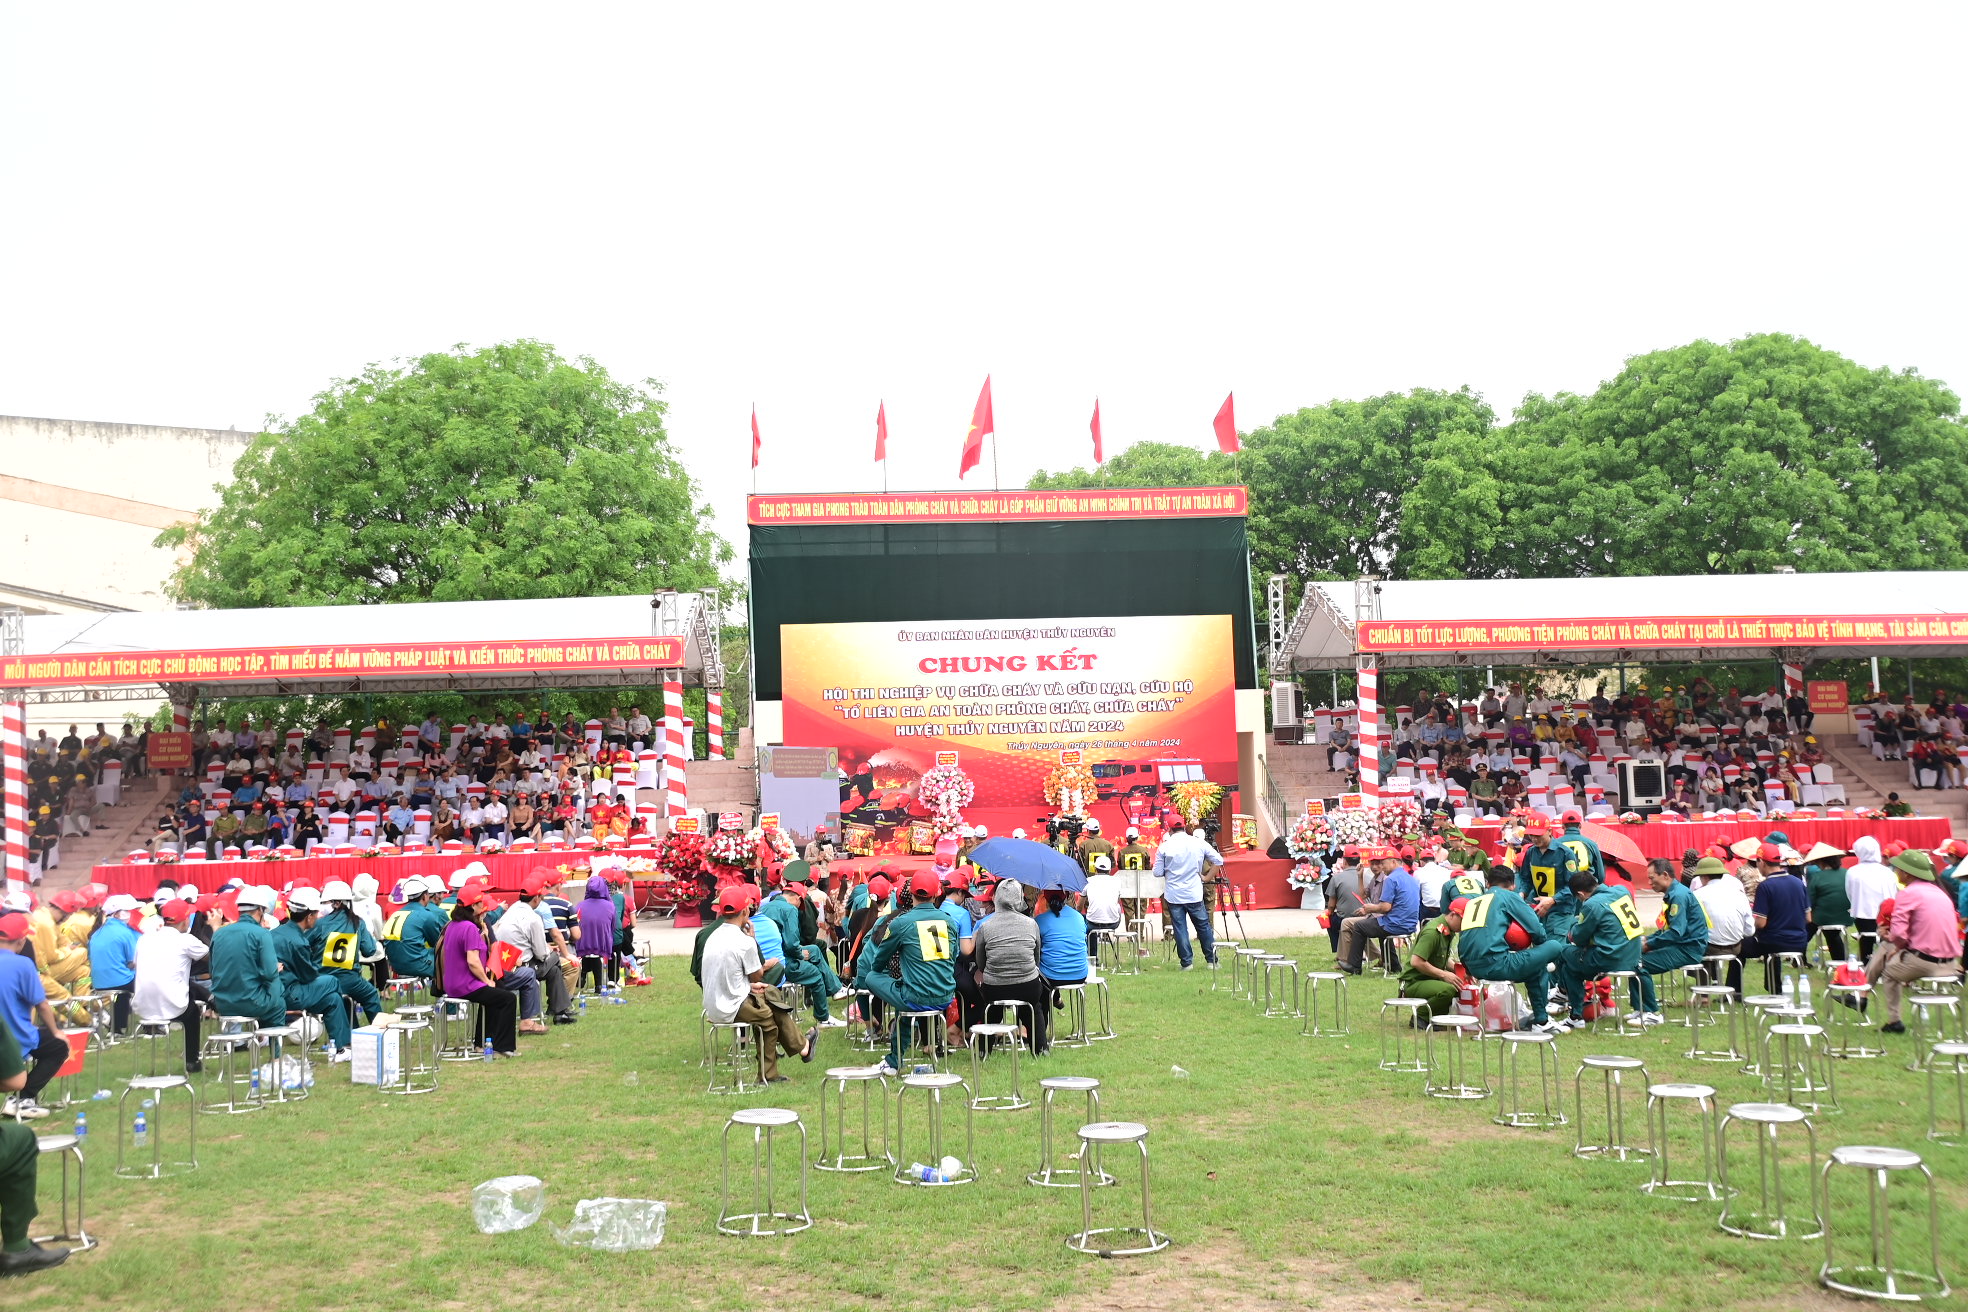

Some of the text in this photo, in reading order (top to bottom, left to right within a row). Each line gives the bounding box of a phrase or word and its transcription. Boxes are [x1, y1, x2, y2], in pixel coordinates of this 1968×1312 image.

[916, 632, 939, 641] BAN
[942, 630, 973, 640] NHÂN
[976, 629, 999, 640] DÂN
[1001, 628, 1038, 640] HUYỆN
[1041, 627, 1068, 638] THỦY
[1071, 627, 1115, 637] NGUYÊN
[1404, 629, 1414, 647] BỊ
[1417, 624, 1432, 643] TỐT
[1435, 627, 1453, 646] LỰC
[1456, 627, 1490, 646] LƯỢNG,
[1492, 626, 1530, 642] PHƯƠNG
[1533, 624, 1554, 645] TIỆN
[1557, 623, 1589, 641] PHÒNG
[1592, 623, 1616, 641] CHÁY
[1618, 622, 1631, 640] VÀ
[1634, 621, 1659, 640] CHỮA
[1662, 622, 1686, 640] CHÁY
[1689, 624, 1703, 643] TẠI
[1706, 619, 1724, 639] CHỖ
[1728, 621, 1739, 639] LÀ
[1741, 620, 1767, 639] THIẾT
[1769, 622, 1794, 642] THỰC
[1796, 619, 1815, 638] BẢO
[1816, 620, 1828, 641] VỆ
[1831, 620, 1853, 638] TÍNH
[1856, 623, 1887, 641] MẠNG,
[1889, 620, 1904, 637] TÀI
[1906, 618, 1927, 637] SẢN
[1929, 617, 1949, 636] CỦA
[5, 659, 25, 679] MỖI
[29, 659, 60, 678] NGƯỜI
[64, 659, 86, 677] DÂN
[114, 657, 136, 675] TÍCH
[140, 658, 161, 677] CỰC
[165, 654, 185, 673] CHỦ
[189, 655, 217, 676] ĐỘNG
[221, 657, 241, 675] HỌC
[245, 653, 267, 674] TẬP,
[271, 652, 289, 670] TÌM
[363, 649, 391, 667] VỮNG
[394, 648, 422, 666] PHÁP
[425, 648, 450, 668] LUẬT
[453, 647, 467, 665] VÀ
[470, 645, 494, 664] KIẾN
[498, 645, 524, 664] THỨC
[527, 644, 563, 663] PHÒNG
[566, 644, 593, 662] CHÁY
[596, 643, 610, 661] VÀ
[613, 642, 640, 661] CHỮA
[644, 642, 670, 659] CHÁY
[918, 647, 1097, 673] CHUNG KẾT
[823, 680, 1194, 702] HỘI THI NGHIỆP VỤ CHỮA CHÁY VÀ CỨU NẠN, CỨU HỘ
[834, 697, 1183, 719] “TỔ LIÊN GIA AN TOÀN PHÒNG CHÁY, CHỮA CHÁY”
[895, 719, 1124, 738] HUYỆN THỦY NGUYÊN NĂM 2024
[1030, 742, 1067, 750] Nguyên,
[1069, 741, 1091, 749] ngày
[1092, 740, 1103, 748] 26
[1104, 740, 1129, 749] tháng
[1528, 818, 1540, 826] 114
[1462, 879, 1474, 890] 3
[1536, 872, 1548, 896] 2
[1472, 902, 1482, 922] 1
[1622, 902, 1640, 929] 5
[390, 914, 400, 936] 1
[927, 924, 942, 953] 1
[332, 938, 348, 963] 6
